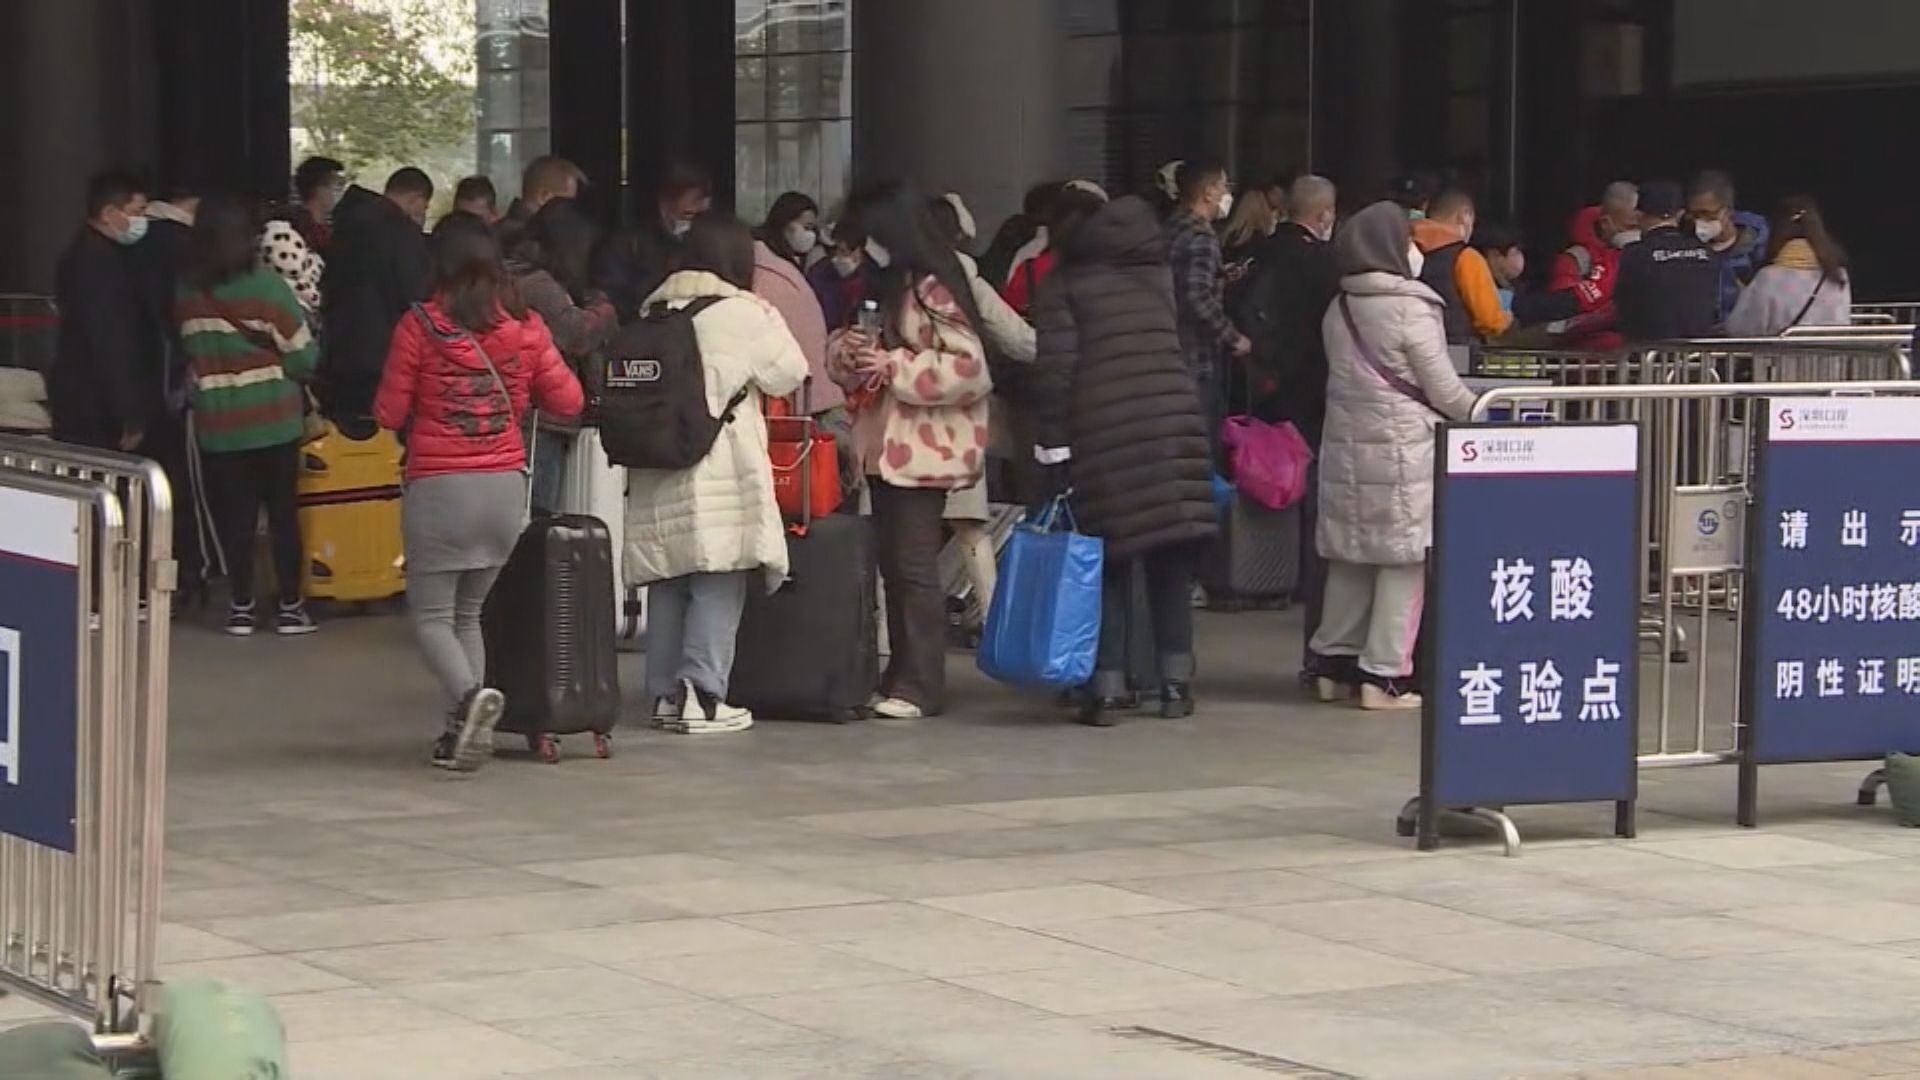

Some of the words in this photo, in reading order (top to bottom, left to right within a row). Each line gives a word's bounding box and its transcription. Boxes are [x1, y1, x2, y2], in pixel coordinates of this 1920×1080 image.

[622, 360, 659, 380] VANS
[1779, 510, 1920, 548] 请出示
[1490, 558, 1594, 623] 核酸
[1777, 583, 1920, 622] 48小时核酸
[1459, 658, 1621, 725] 查验点
[1776, 658, 1920, 698] 阴性证明
